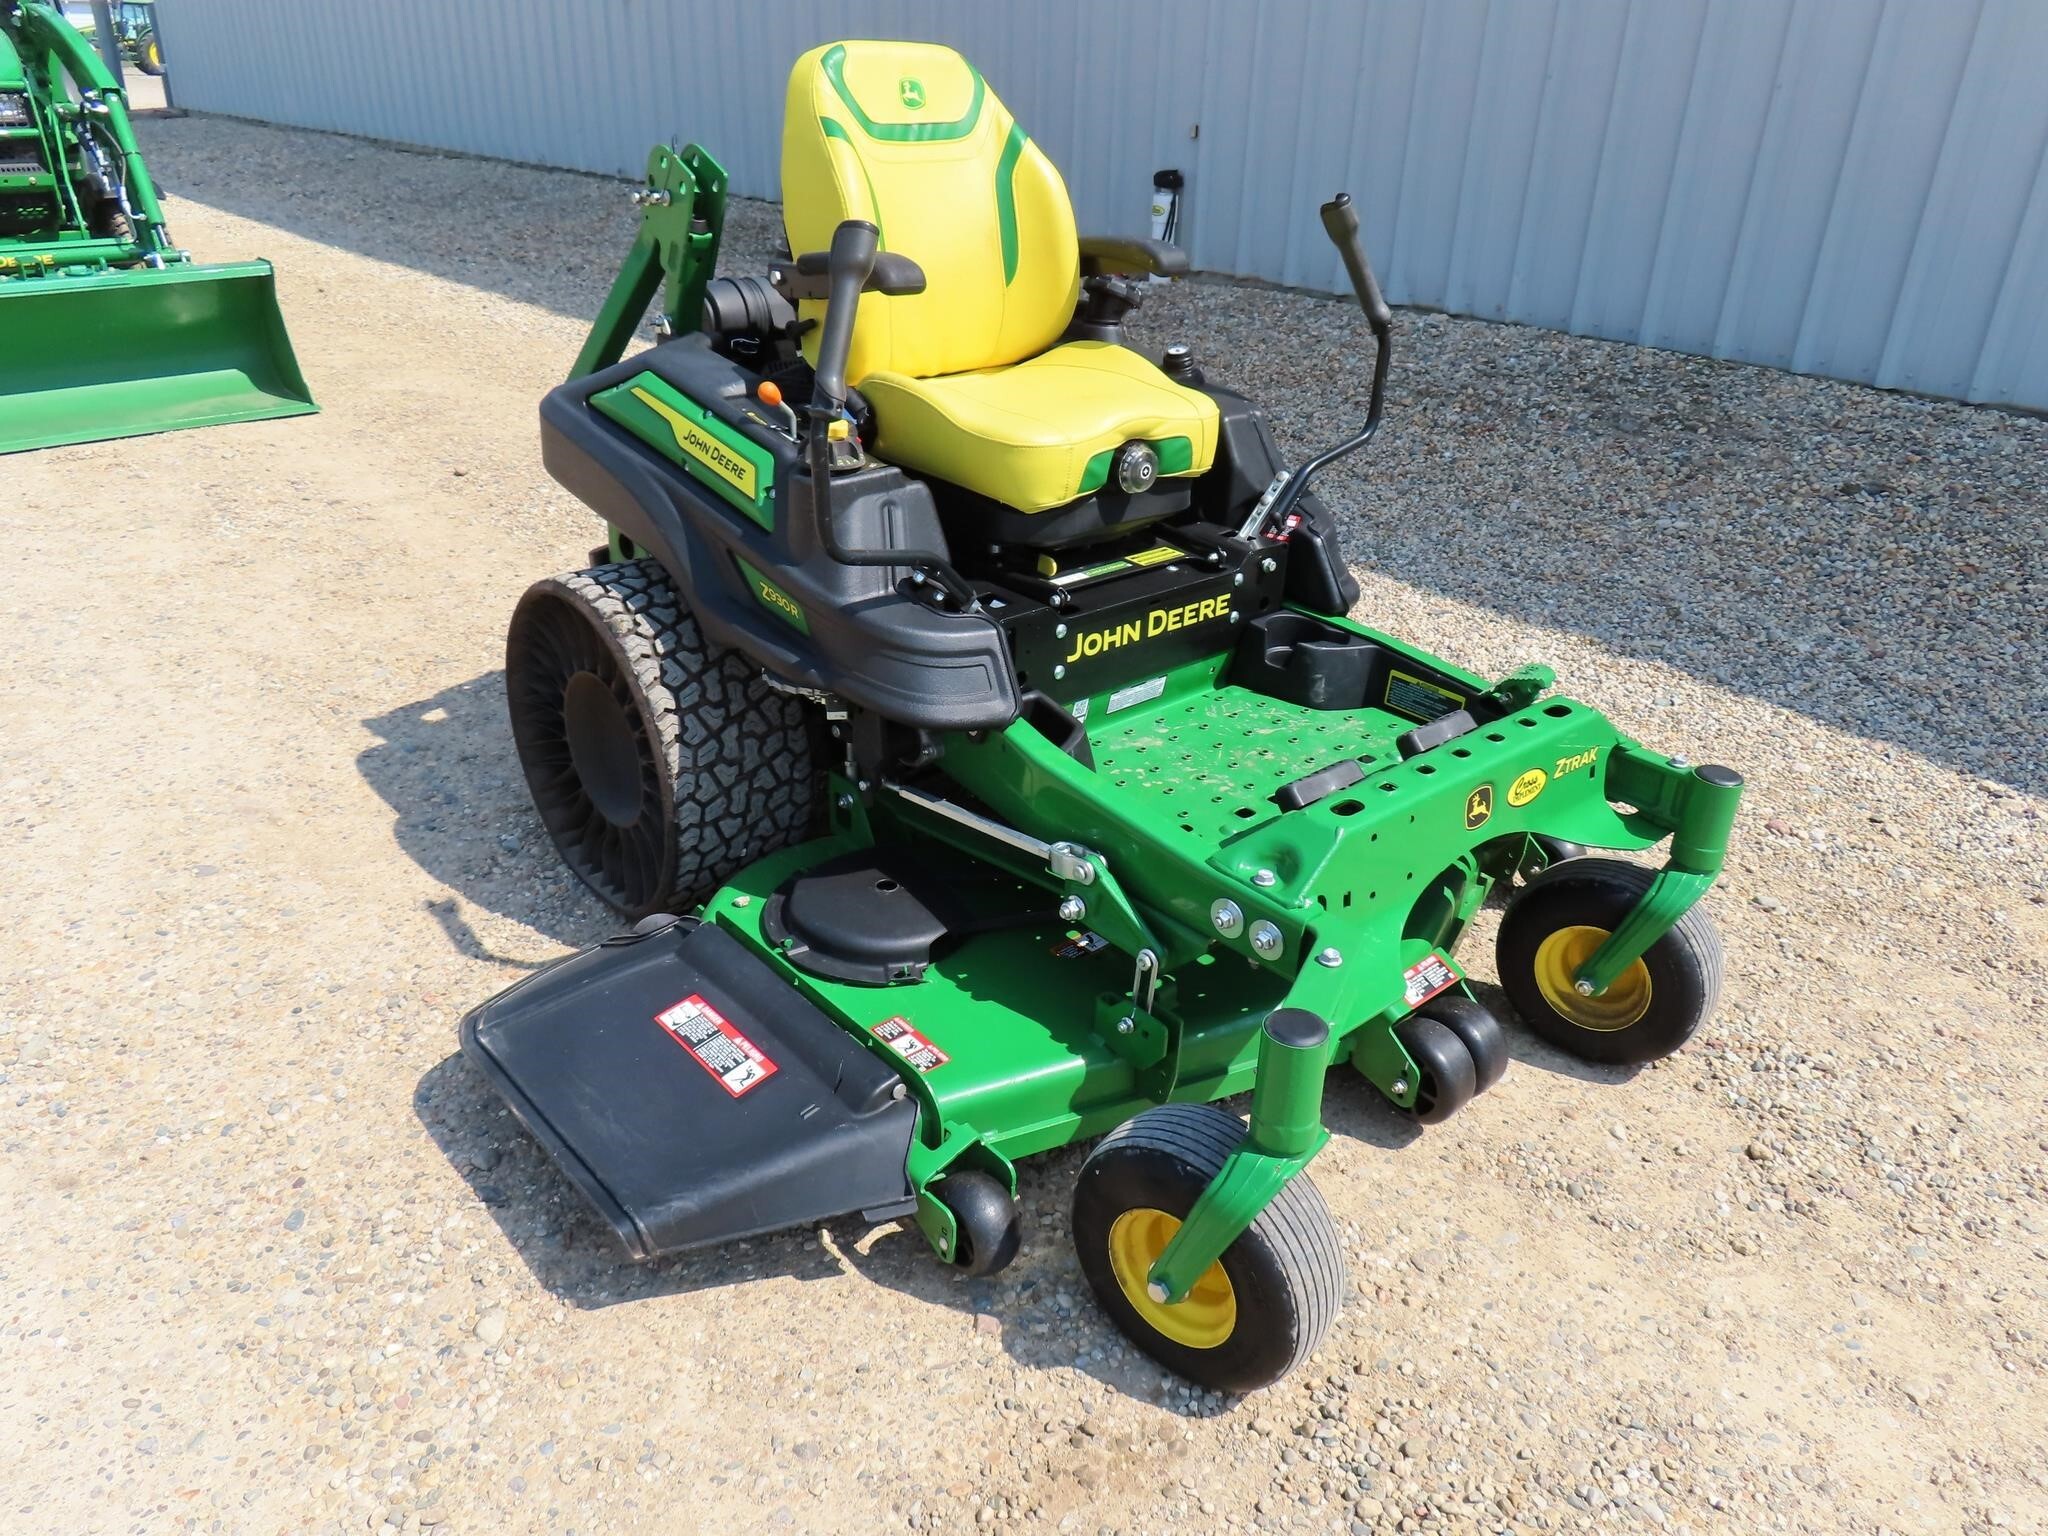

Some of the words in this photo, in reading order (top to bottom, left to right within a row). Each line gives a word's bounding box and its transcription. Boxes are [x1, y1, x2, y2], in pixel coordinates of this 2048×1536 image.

[683, 430, 711, 455] JOHN
[711, 447, 746, 480] DEERE
[759, 581, 799, 619] Z930R
[1066, 620, 1141, 663] JOHN
[1147, 593, 1231, 637] DEERE
[1553, 746, 1599, 779] ZTRAK
